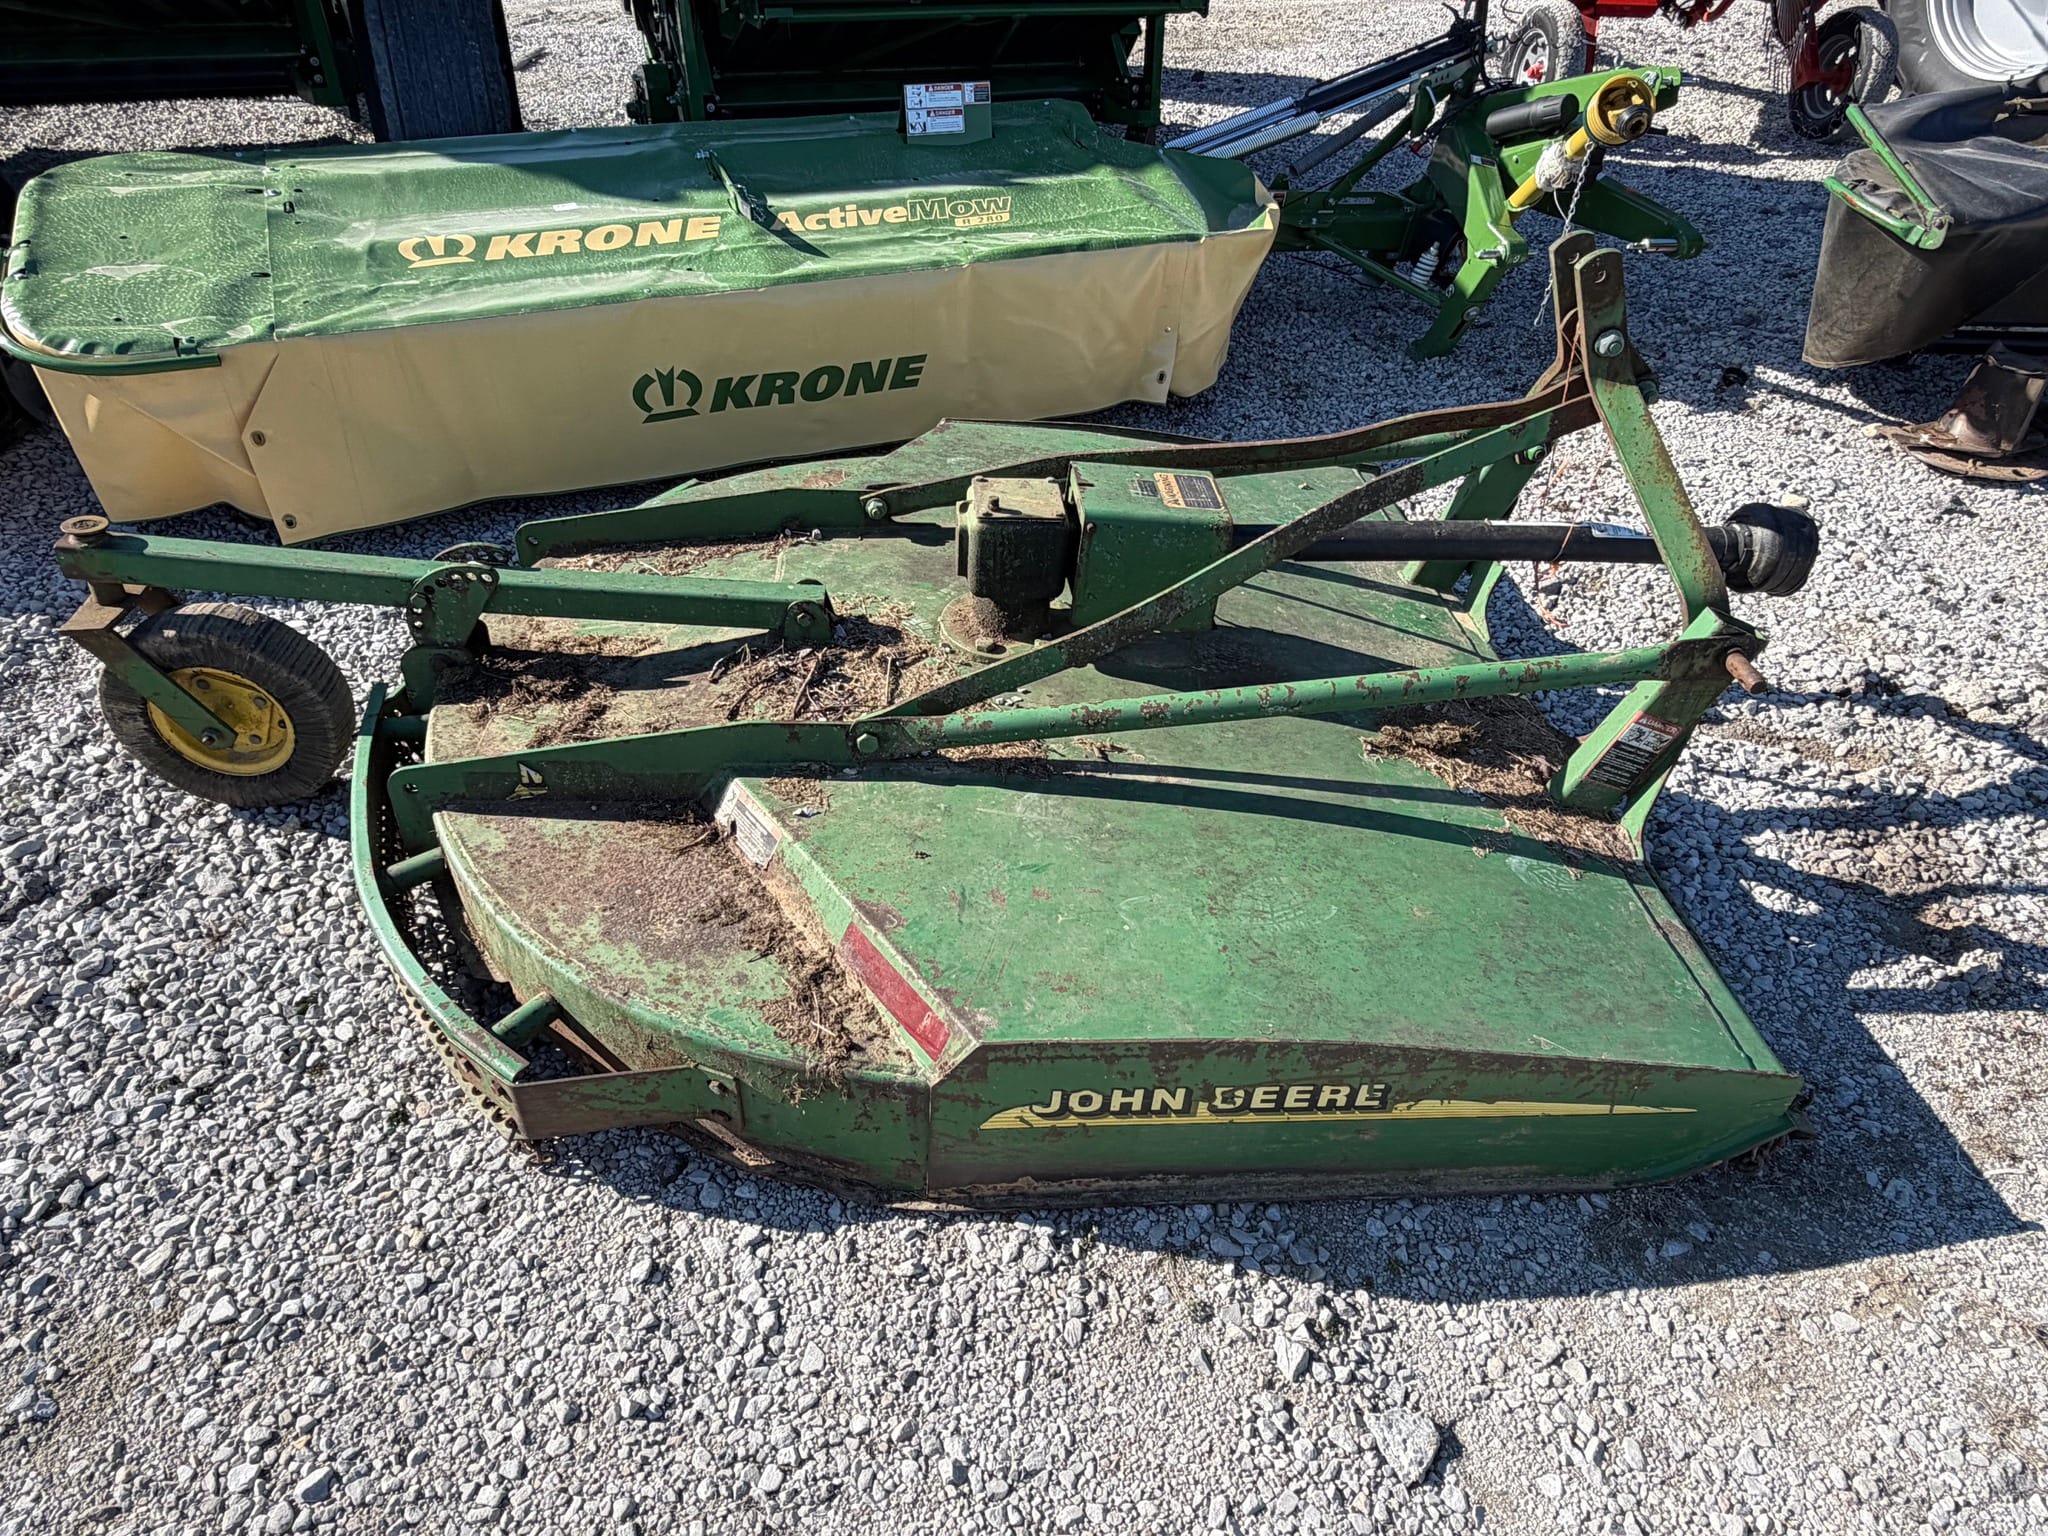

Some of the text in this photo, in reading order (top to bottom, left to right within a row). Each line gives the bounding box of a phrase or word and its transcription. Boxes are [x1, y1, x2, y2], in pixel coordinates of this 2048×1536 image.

[770, 197, 1011, 231] ActiveMow
[485, 216, 721, 260] KRONE
[709, 354, 927, 413] KRONE
[1030, 1083, 1389, 1116] JOHN DEERE
